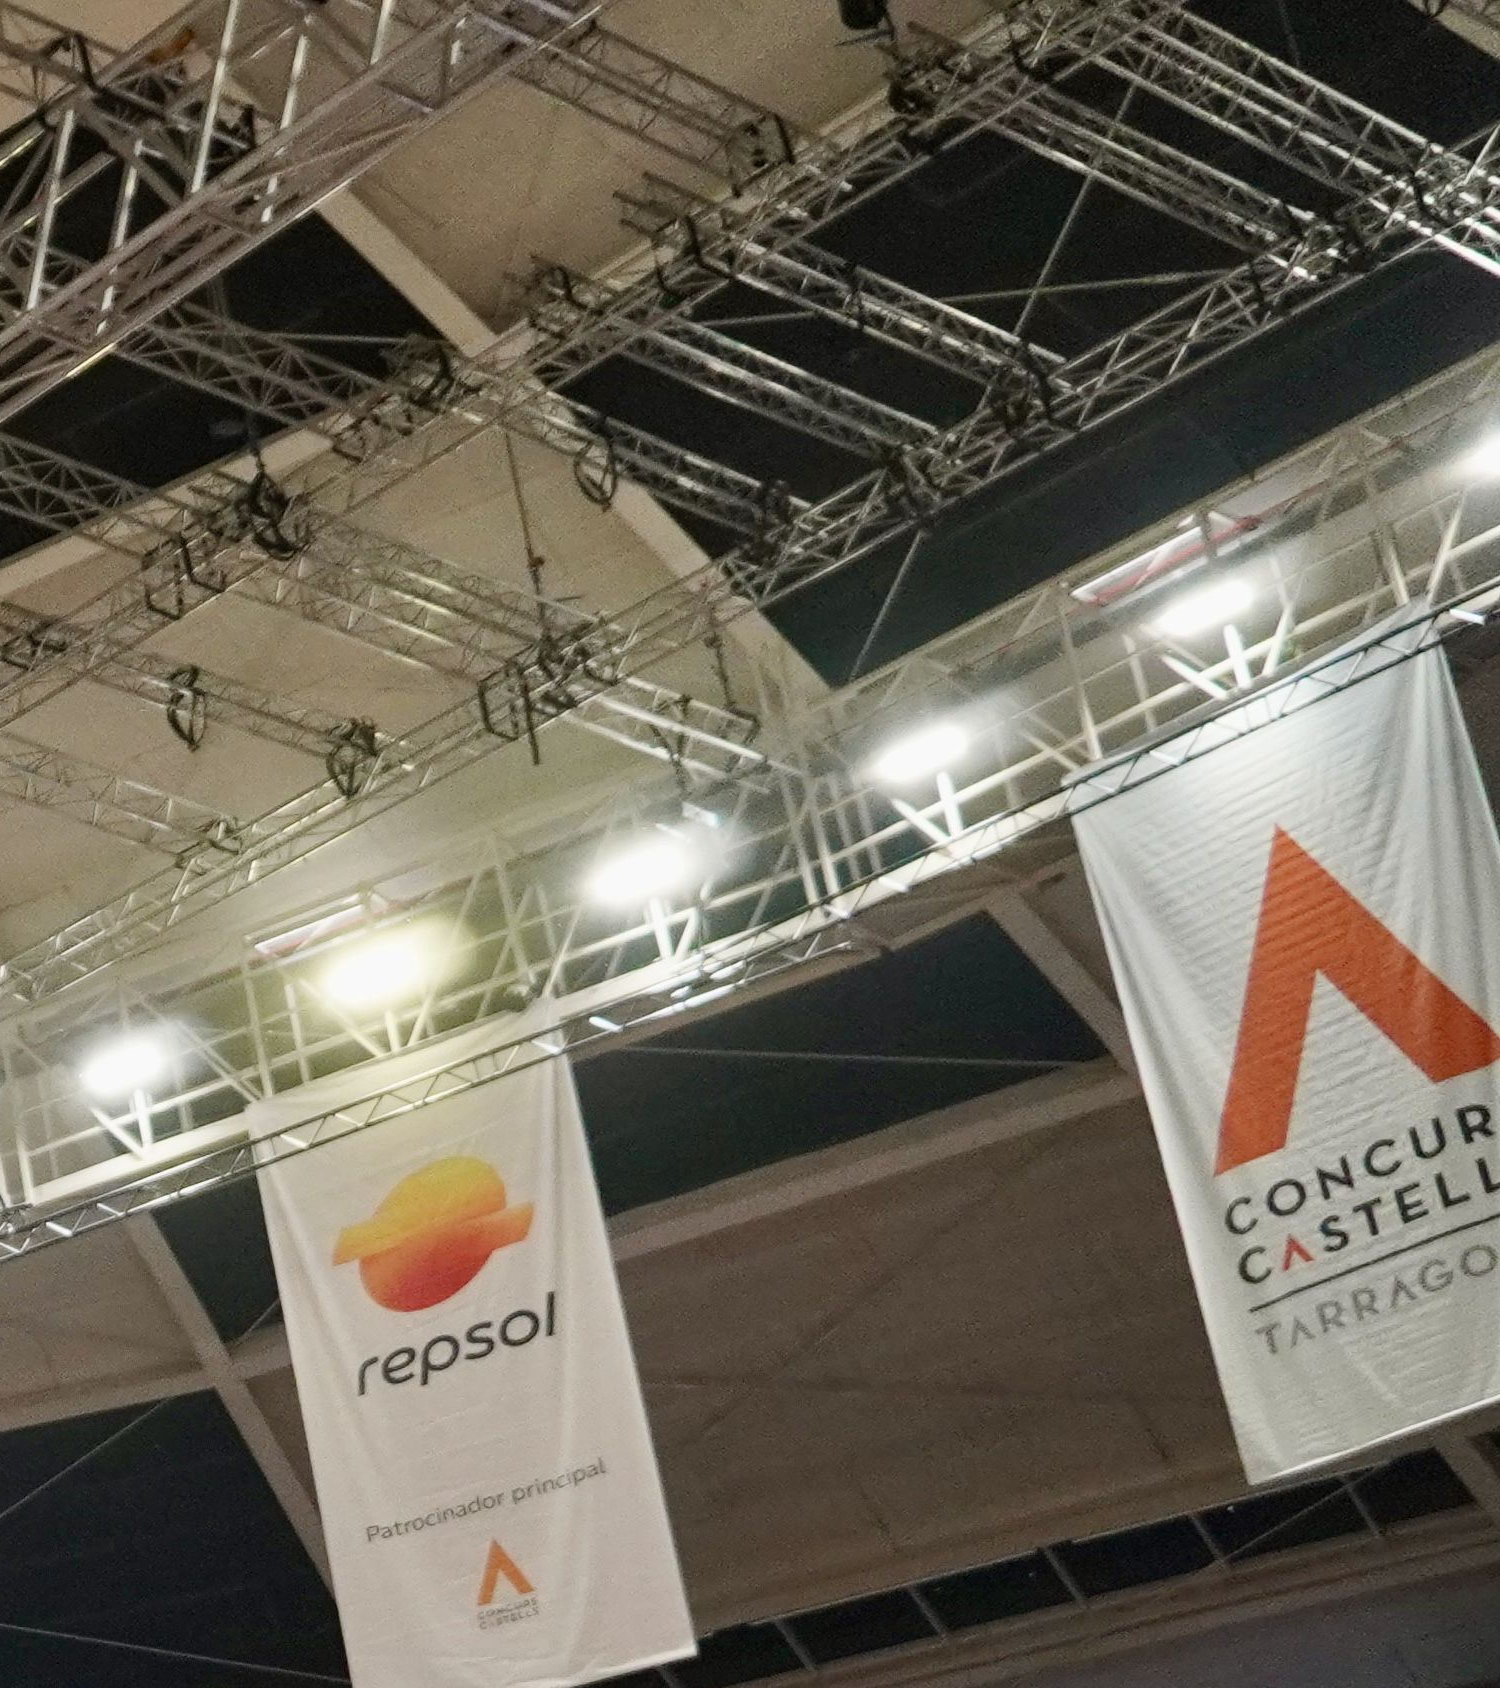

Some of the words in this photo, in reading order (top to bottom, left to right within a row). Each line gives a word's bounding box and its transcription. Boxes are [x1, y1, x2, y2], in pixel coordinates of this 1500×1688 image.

[1223, 1103, 1494, 1236] CONCUR
[1238, 1157, 1500, 1286] CASTELL
[357, 1291, 556, 1396] repsol
[1255, 1243, 1499, 1355] TARRAGO
[366, 1488, 506, 1544] Patrocinador
[511, 1457, 608, 1506] principal
